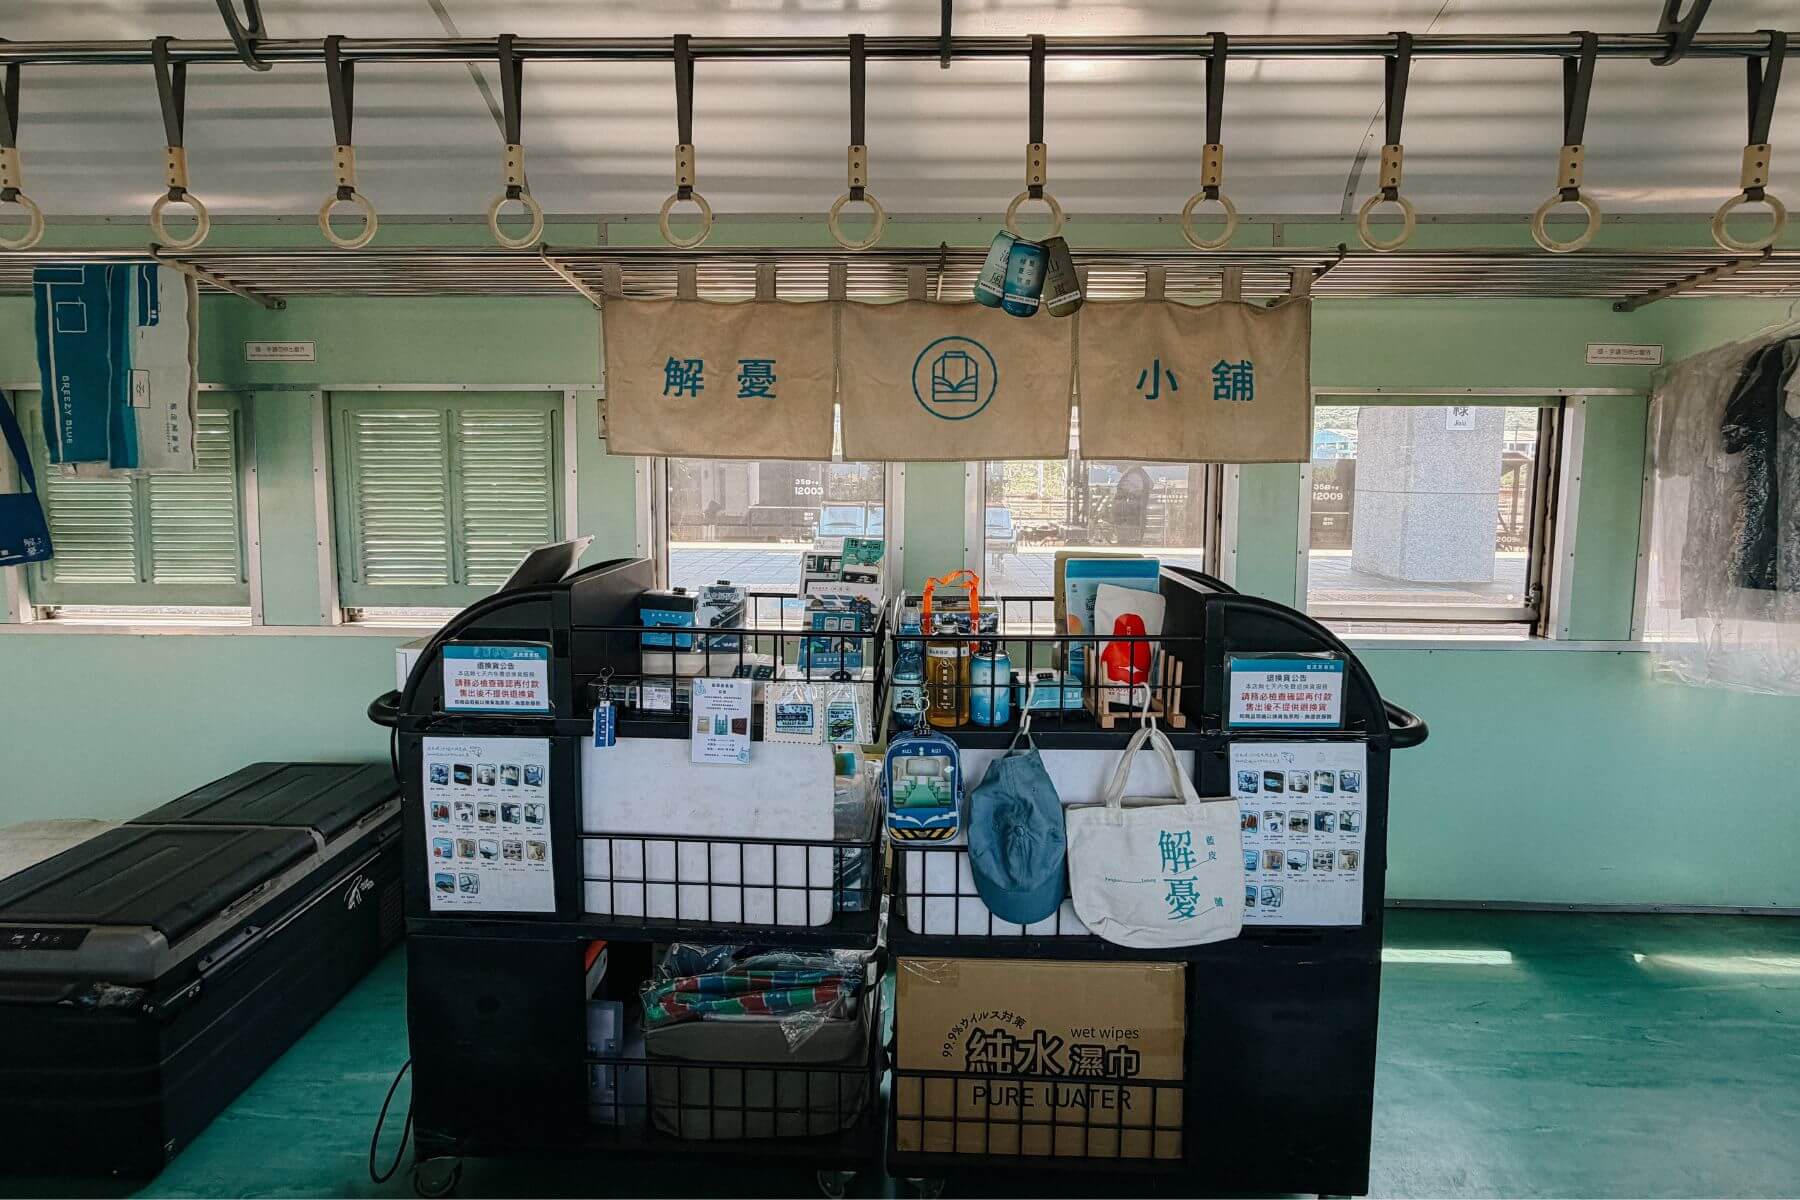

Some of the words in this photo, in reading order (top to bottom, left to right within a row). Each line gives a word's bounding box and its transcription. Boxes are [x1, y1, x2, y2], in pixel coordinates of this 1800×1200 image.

[663, 356, 777, 399] 解憂
[1136, 358, 1254, 401] 小舖
[61, 375, 72, 416] BREEZY
[65, 419, 73, 444] BLUE
[1241, 692, 1333, 701] 請務必檢查確認再付款
[1246, 702, 1328, 712] 售出後不提供退換貨
[1158, 829, 1201, 921] 解憂
[1070, 1026, 1095, 1039] wet
[1099, 1026, 1140, 1042] wipes
[972, 1085, 1034, 1108] PURE
